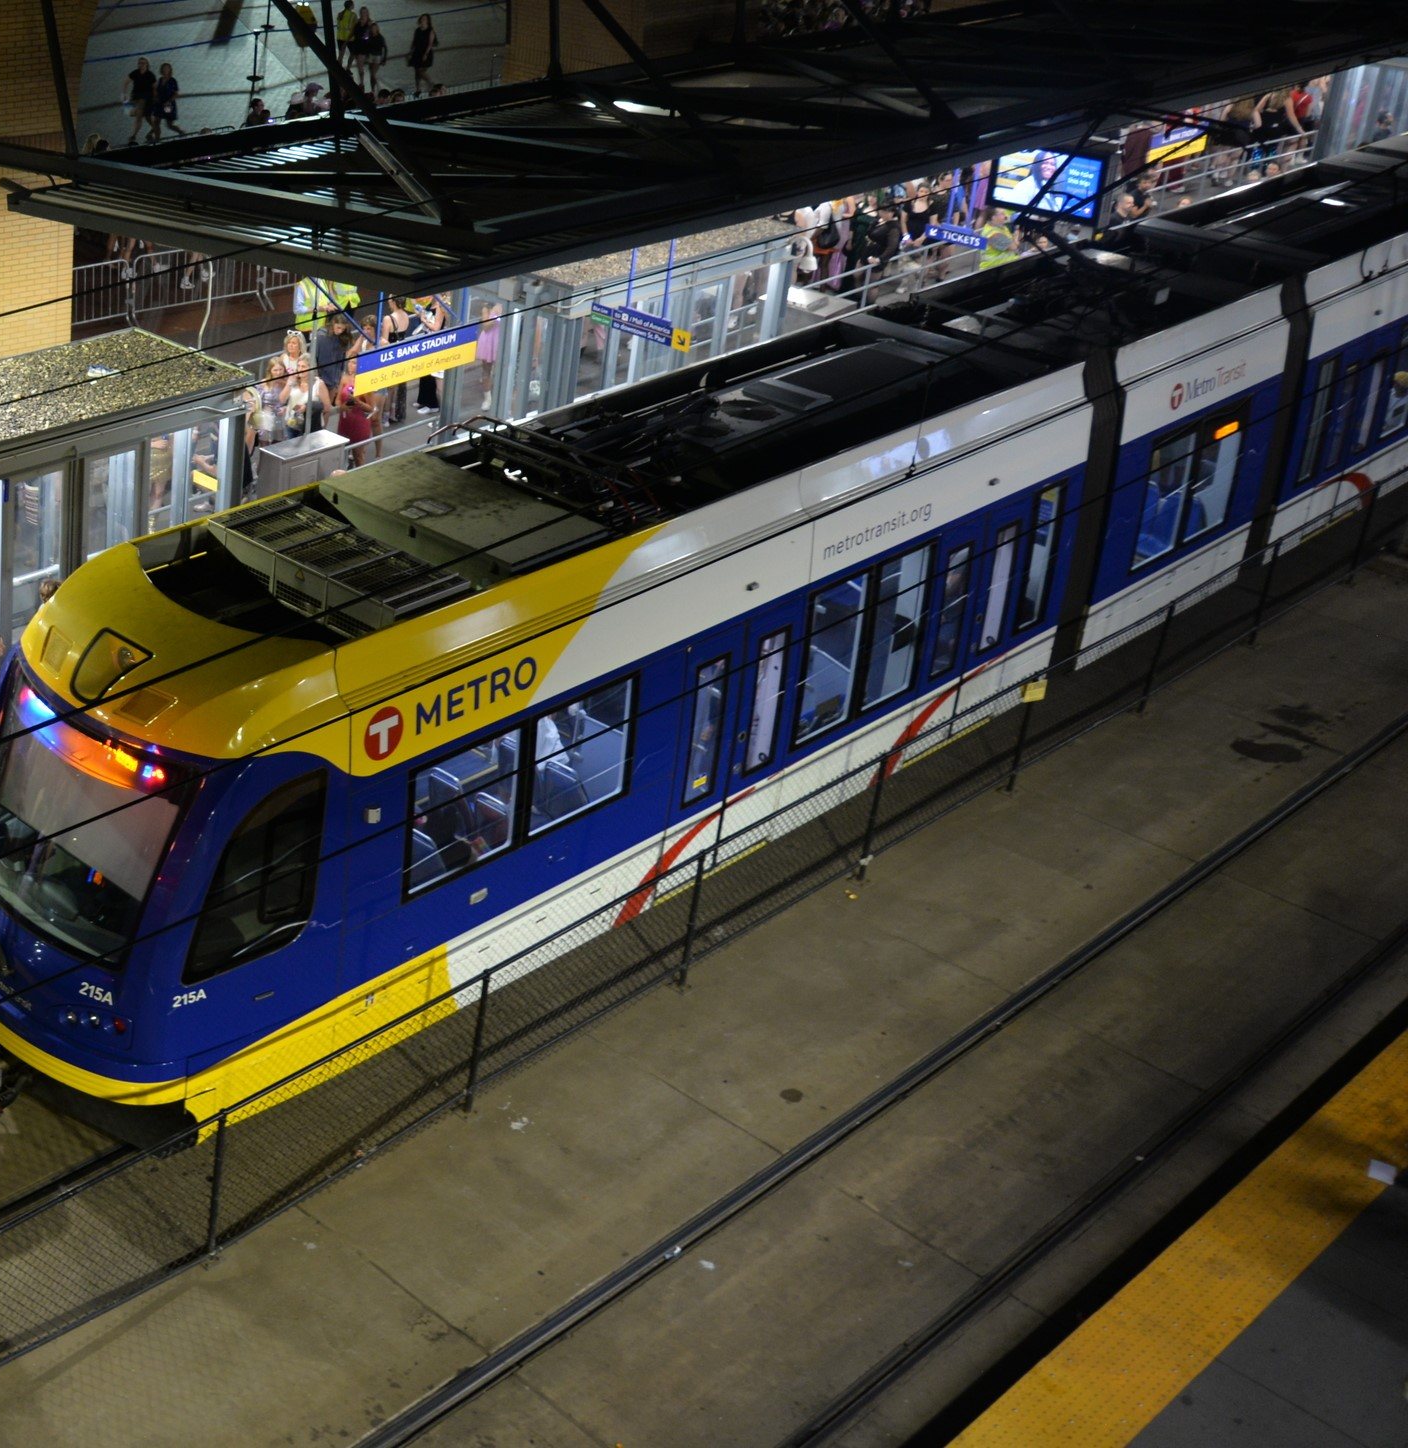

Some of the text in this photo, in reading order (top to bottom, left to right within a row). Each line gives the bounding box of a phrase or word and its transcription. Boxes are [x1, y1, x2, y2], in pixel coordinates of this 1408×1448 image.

[942, 230, 981, 247] TICKETS
[620, 323, 647, 337] downtown
[654, 333, 666, 343] Paul
[632, 317, 643, 325] Mall
[649, 322, 671, 335] America
[380, 333, 457, 363] U.S. BANK STADIUM
[391, 367, 405, 379] Paul
[411, 361, 425, 374] Mall
[426, 359, 434, 369] of
[434, 353, 462, 366] America
[823, 502, 932, 560] metrotransit.org
[415, 656, 537, 736] METRO
[78, 981, 114, 1006] 215A
[172, 988, 207, 1008] 215A
